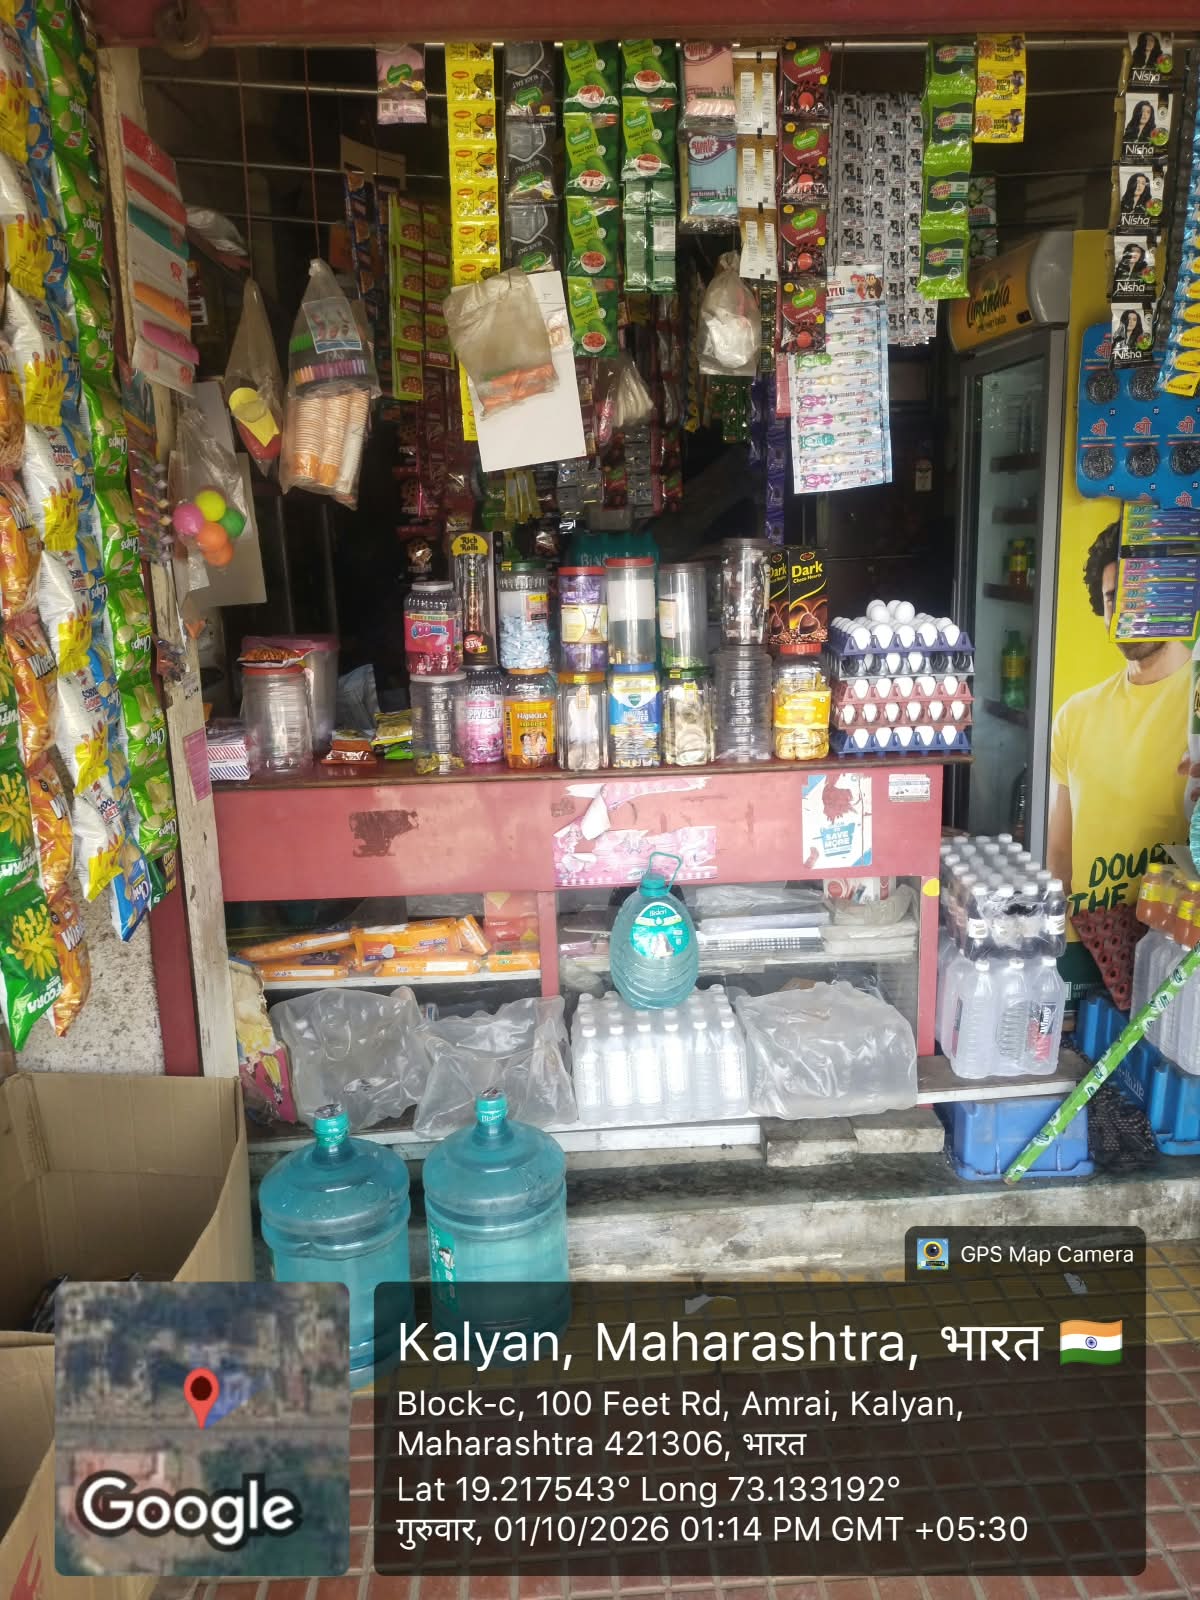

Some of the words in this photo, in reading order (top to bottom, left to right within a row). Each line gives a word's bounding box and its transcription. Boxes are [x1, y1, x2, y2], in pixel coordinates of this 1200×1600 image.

[1132, 70, 1161, 83] Nisha
[1125, 144, 1155, 156] Nisha
[1121, 214, 1150, 226] Nisha
[1116, 281, 1145, 293] Nisha
[1114, 350, 1142, 360] Nisha
[460, 536, 478, 545] Rich
[791, 560, 823, 578] Dark
[825, 831, 849, 841] SAVE
[1088, 842, 1176, 889] DOUB
[1068, 882, 1129, 916] THE
